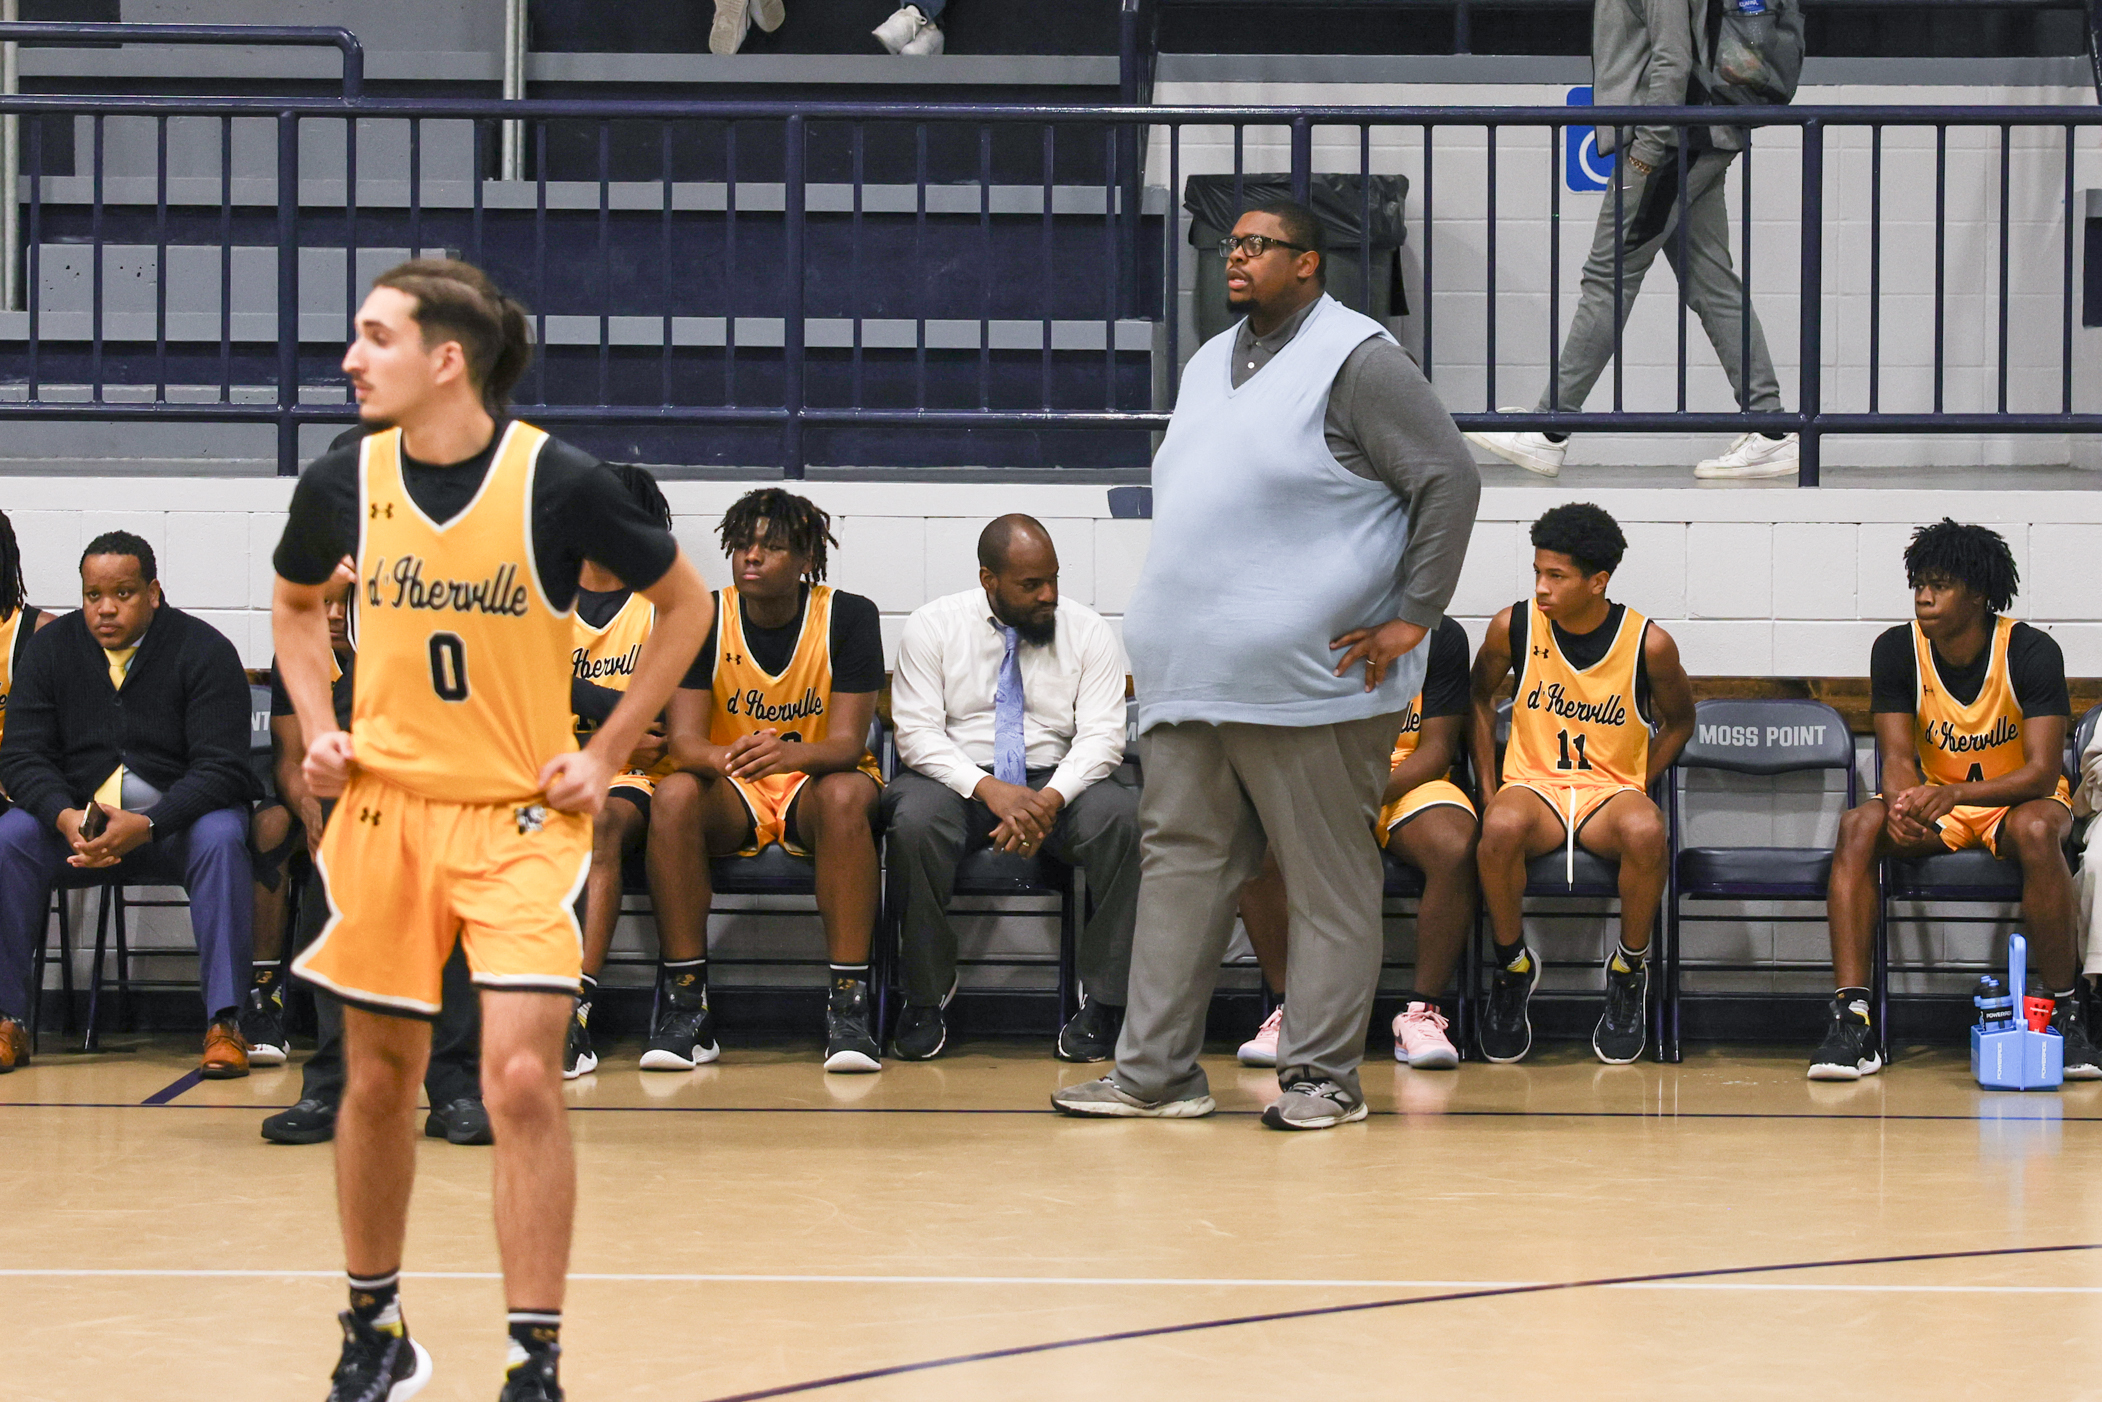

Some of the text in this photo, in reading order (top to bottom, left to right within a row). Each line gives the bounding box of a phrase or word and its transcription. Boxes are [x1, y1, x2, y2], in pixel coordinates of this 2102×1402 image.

[367, 554, 529, 617] d'Iberville
[427, 630, 471, 703] 0
[571, 644, 642, 680] Ibervill
[1526, 680, 1626, 726] d'Iberville
[1556, 728, 1593, 770] 11
[1698, 724, 1827, 747] MOSS POINT
[1925, 715, 2019, 753] d'Iberville
[1986, 1010, 2012, 1019] POWERAD
